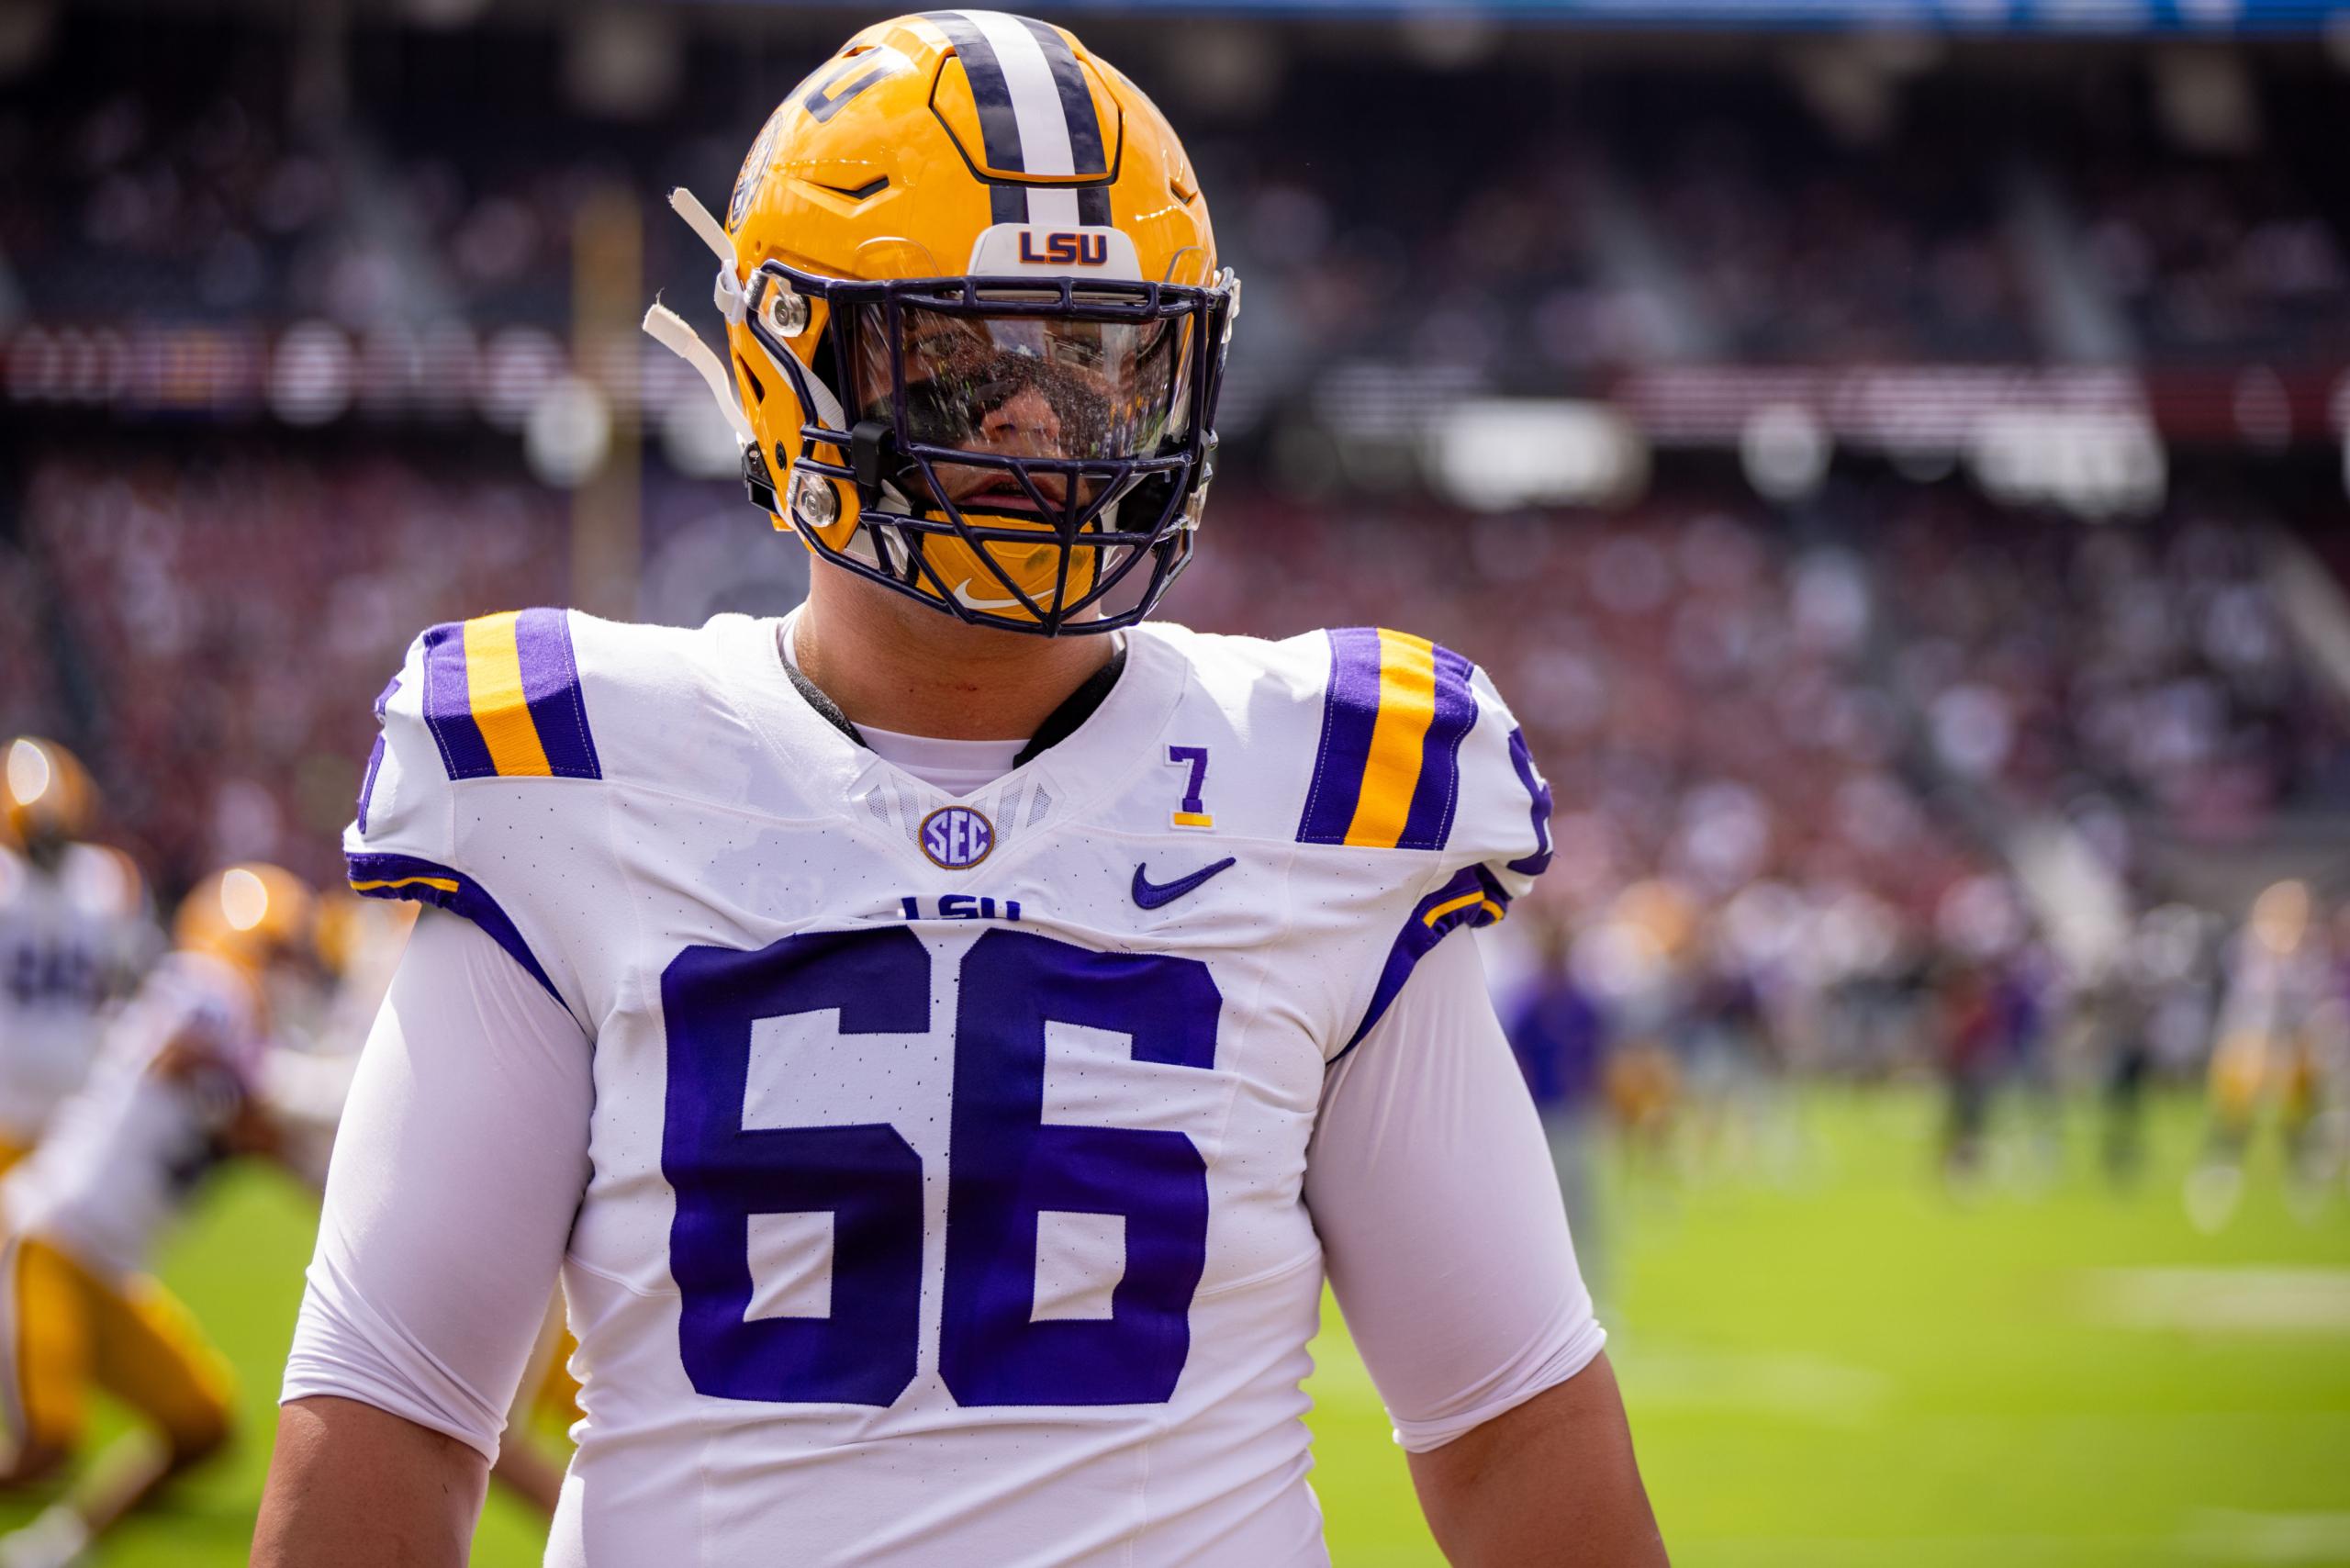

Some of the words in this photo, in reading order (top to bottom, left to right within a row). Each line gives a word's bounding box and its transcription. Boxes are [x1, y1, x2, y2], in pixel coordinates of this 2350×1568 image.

[1020, 231, 1107, 266] LSU
[1169, 745, 1208, 813] 7
[925, 810, 988, 864] SEC
[661, 925, 1223, 1407] 66
